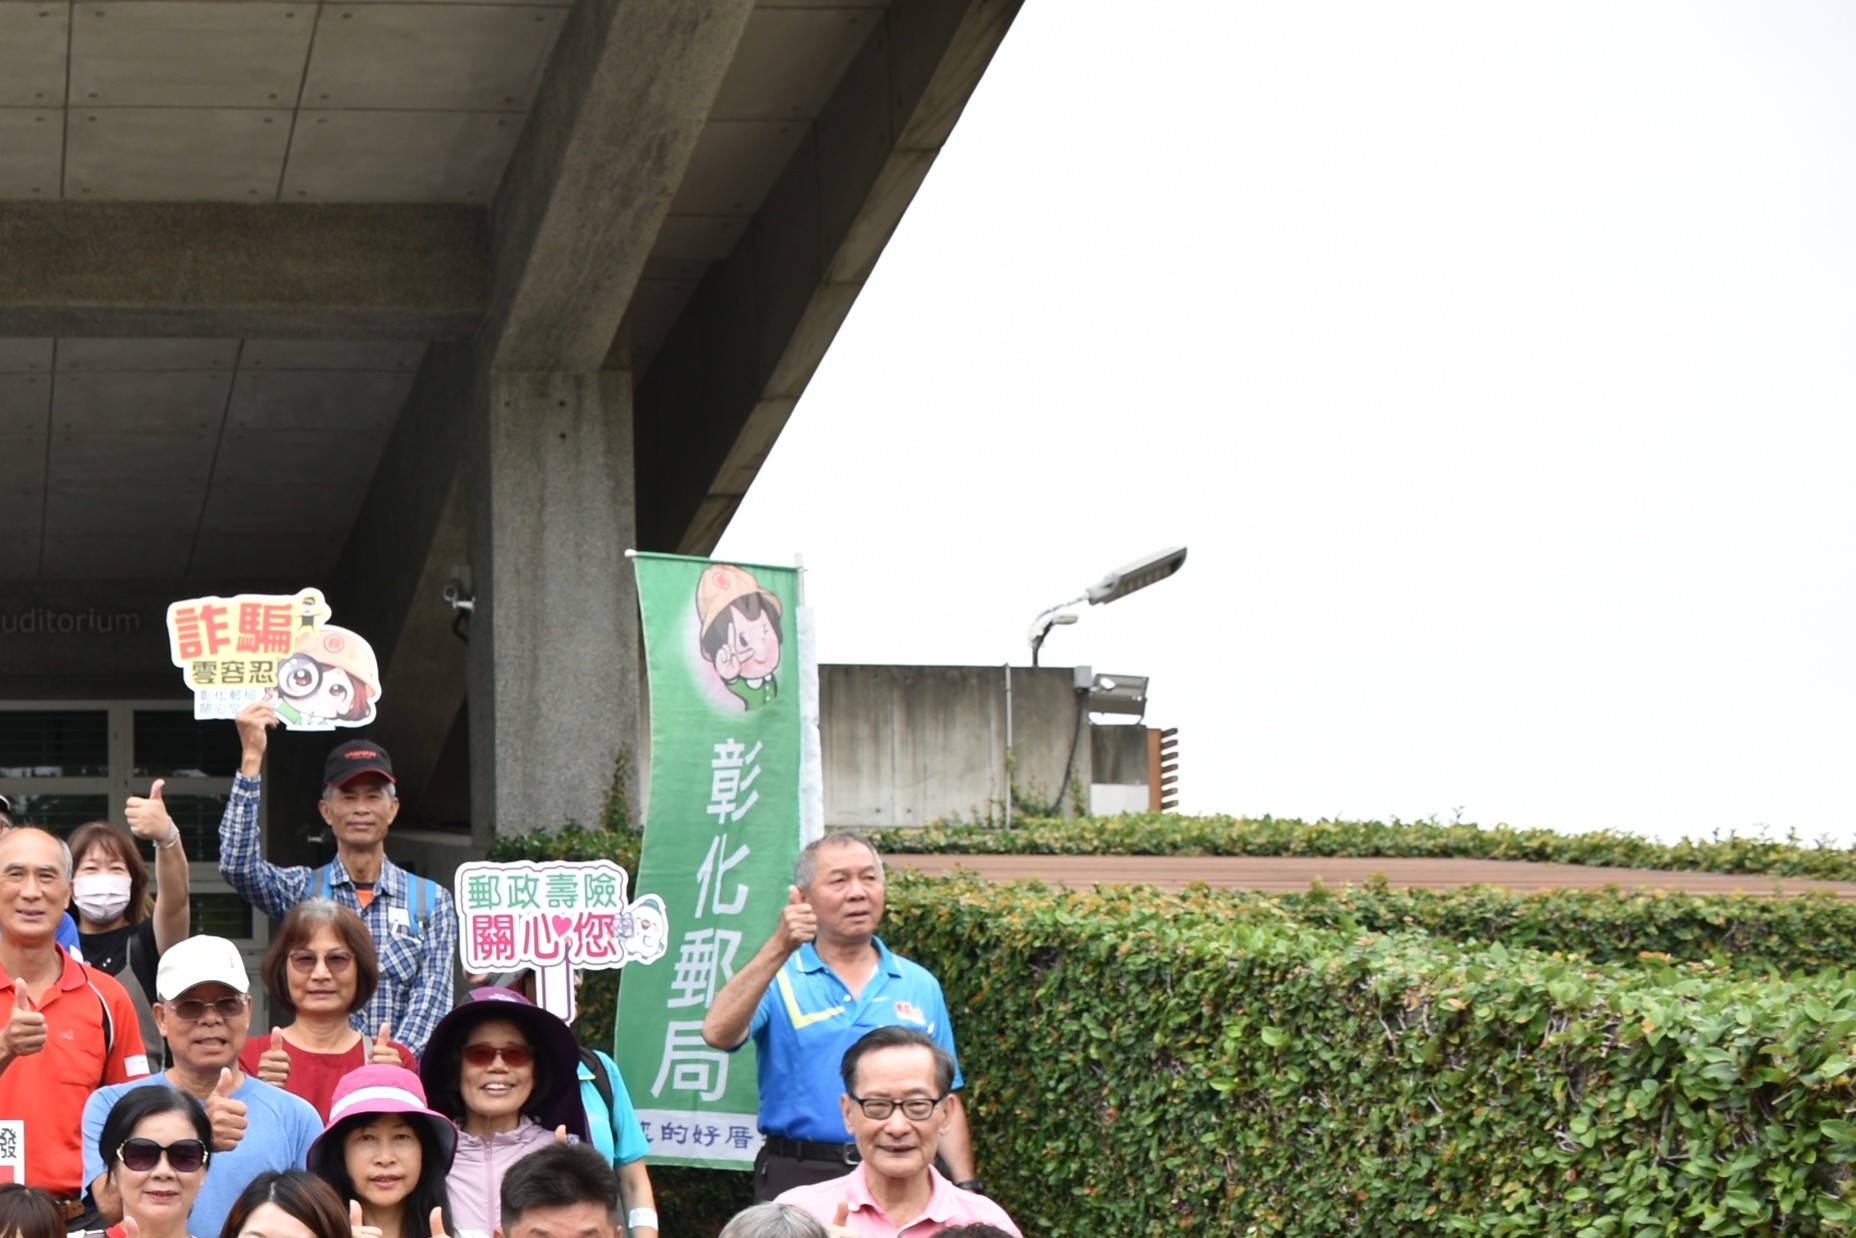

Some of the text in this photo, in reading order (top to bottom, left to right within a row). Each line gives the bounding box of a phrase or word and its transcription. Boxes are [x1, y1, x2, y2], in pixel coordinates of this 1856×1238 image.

[174, 602, 293, 660] 詐騙
[192, 660, 274, 685] 零容忍
[467, 872, 617, 910] 郵政壽險
[472, 911, 617, 961] 關心您
[650, 737, 763, 1101] 彰化郵局
[644, 1119, 764, 1150] 的好厝
